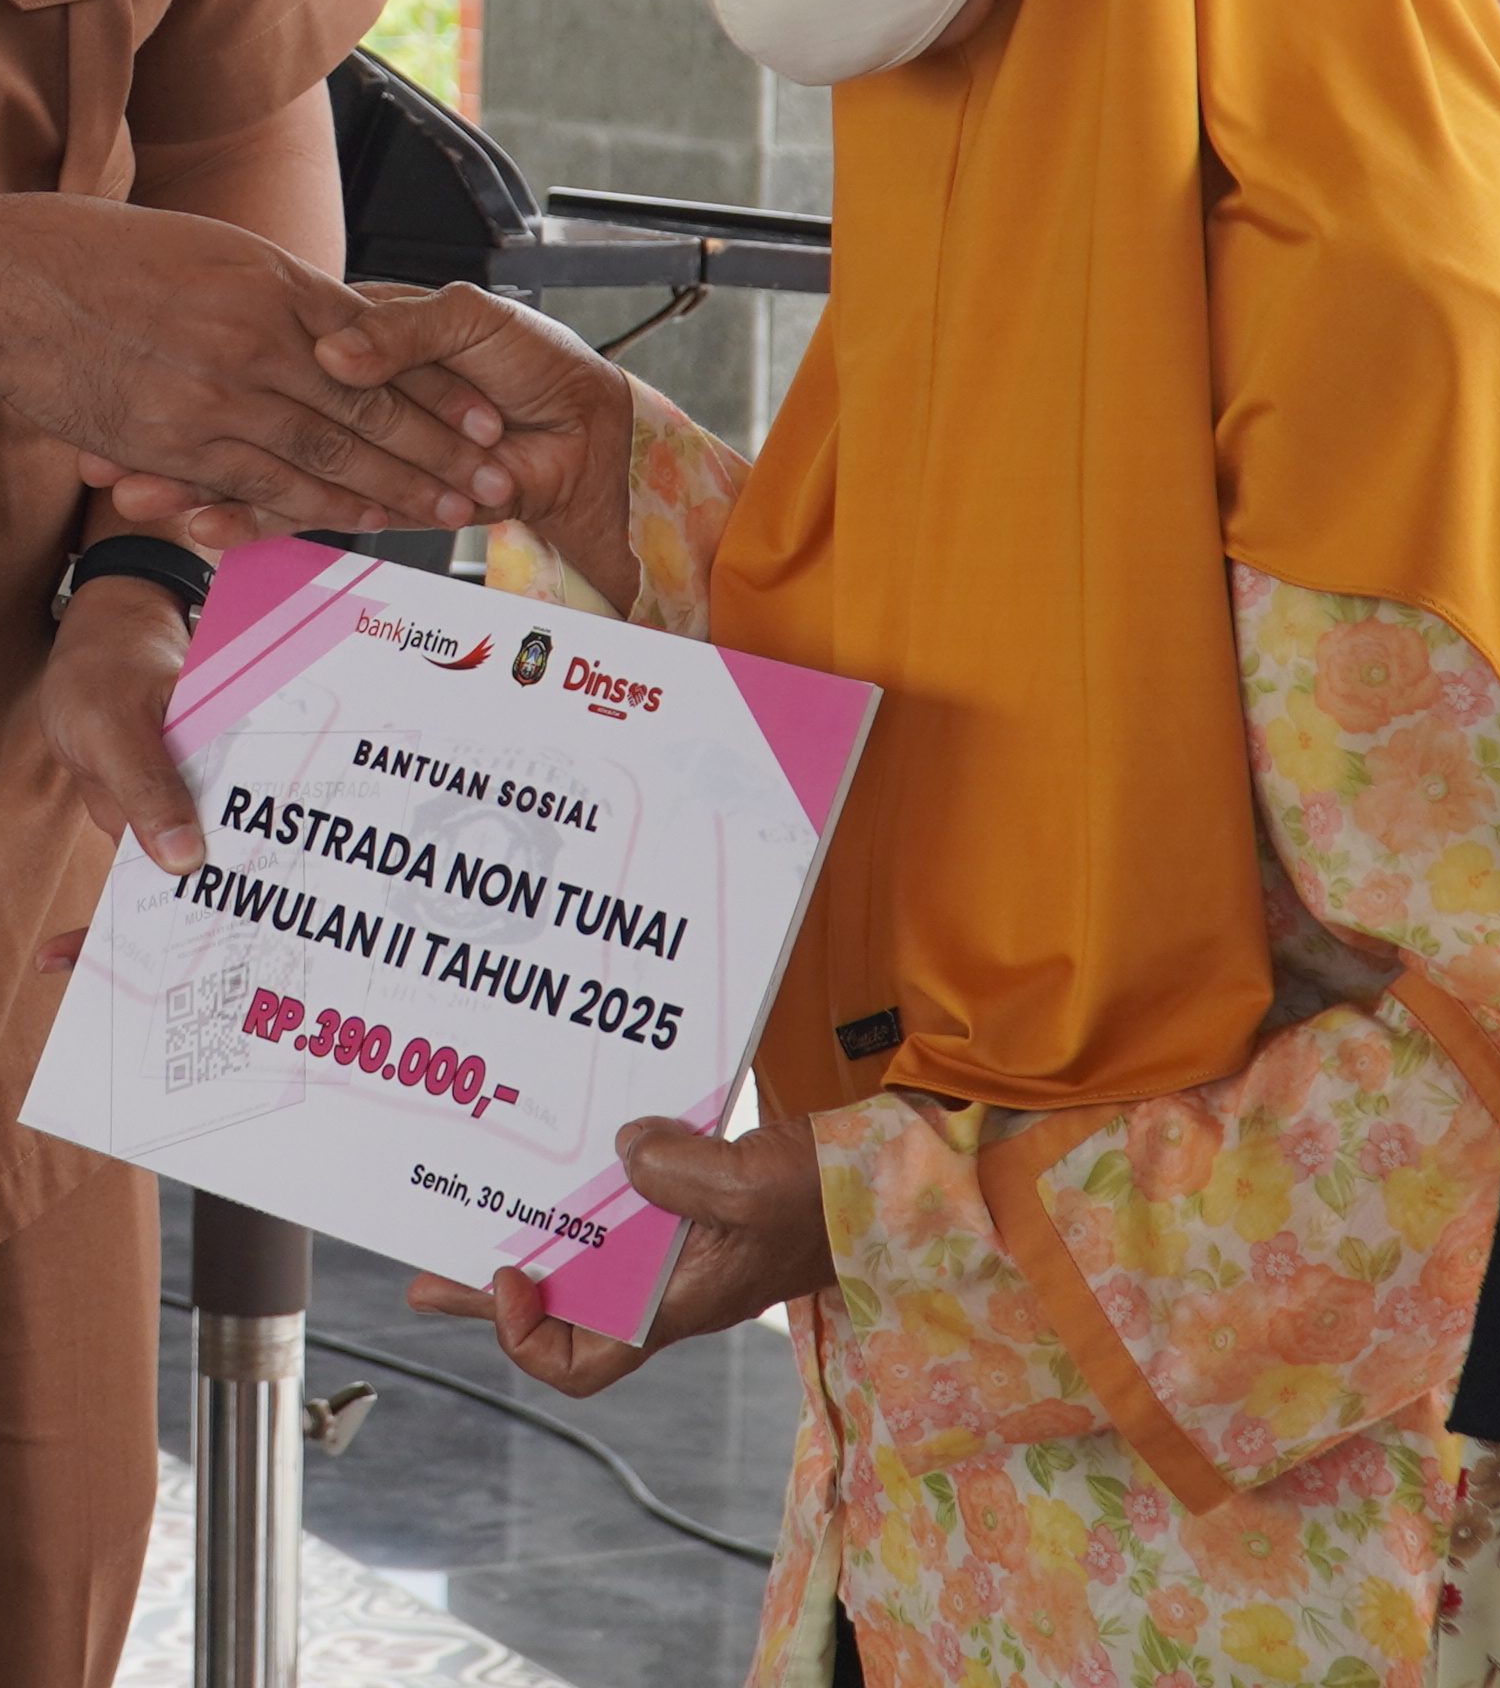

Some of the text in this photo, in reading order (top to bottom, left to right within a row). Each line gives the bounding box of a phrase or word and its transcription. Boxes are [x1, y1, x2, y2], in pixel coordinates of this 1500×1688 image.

[354, 608, 460, 658] bankjatim
[352, 738, 491, 801] BANTUAN
[497, 780, 600, 833] SOSIAL
[220, 785, 689, 962] RASTRADA NON TUNAI
[174, 863, 385, 959] TRIWULAN
[383, 922, 416, 969] II
[421, 932, 570, 1018] TAHUN
[569, 979, 684, 1050] 2025
[242, 986, 520, 1119] RP.390.000,-
[410, 1163, 608, 1249] Senin, 30 Juni 2025
